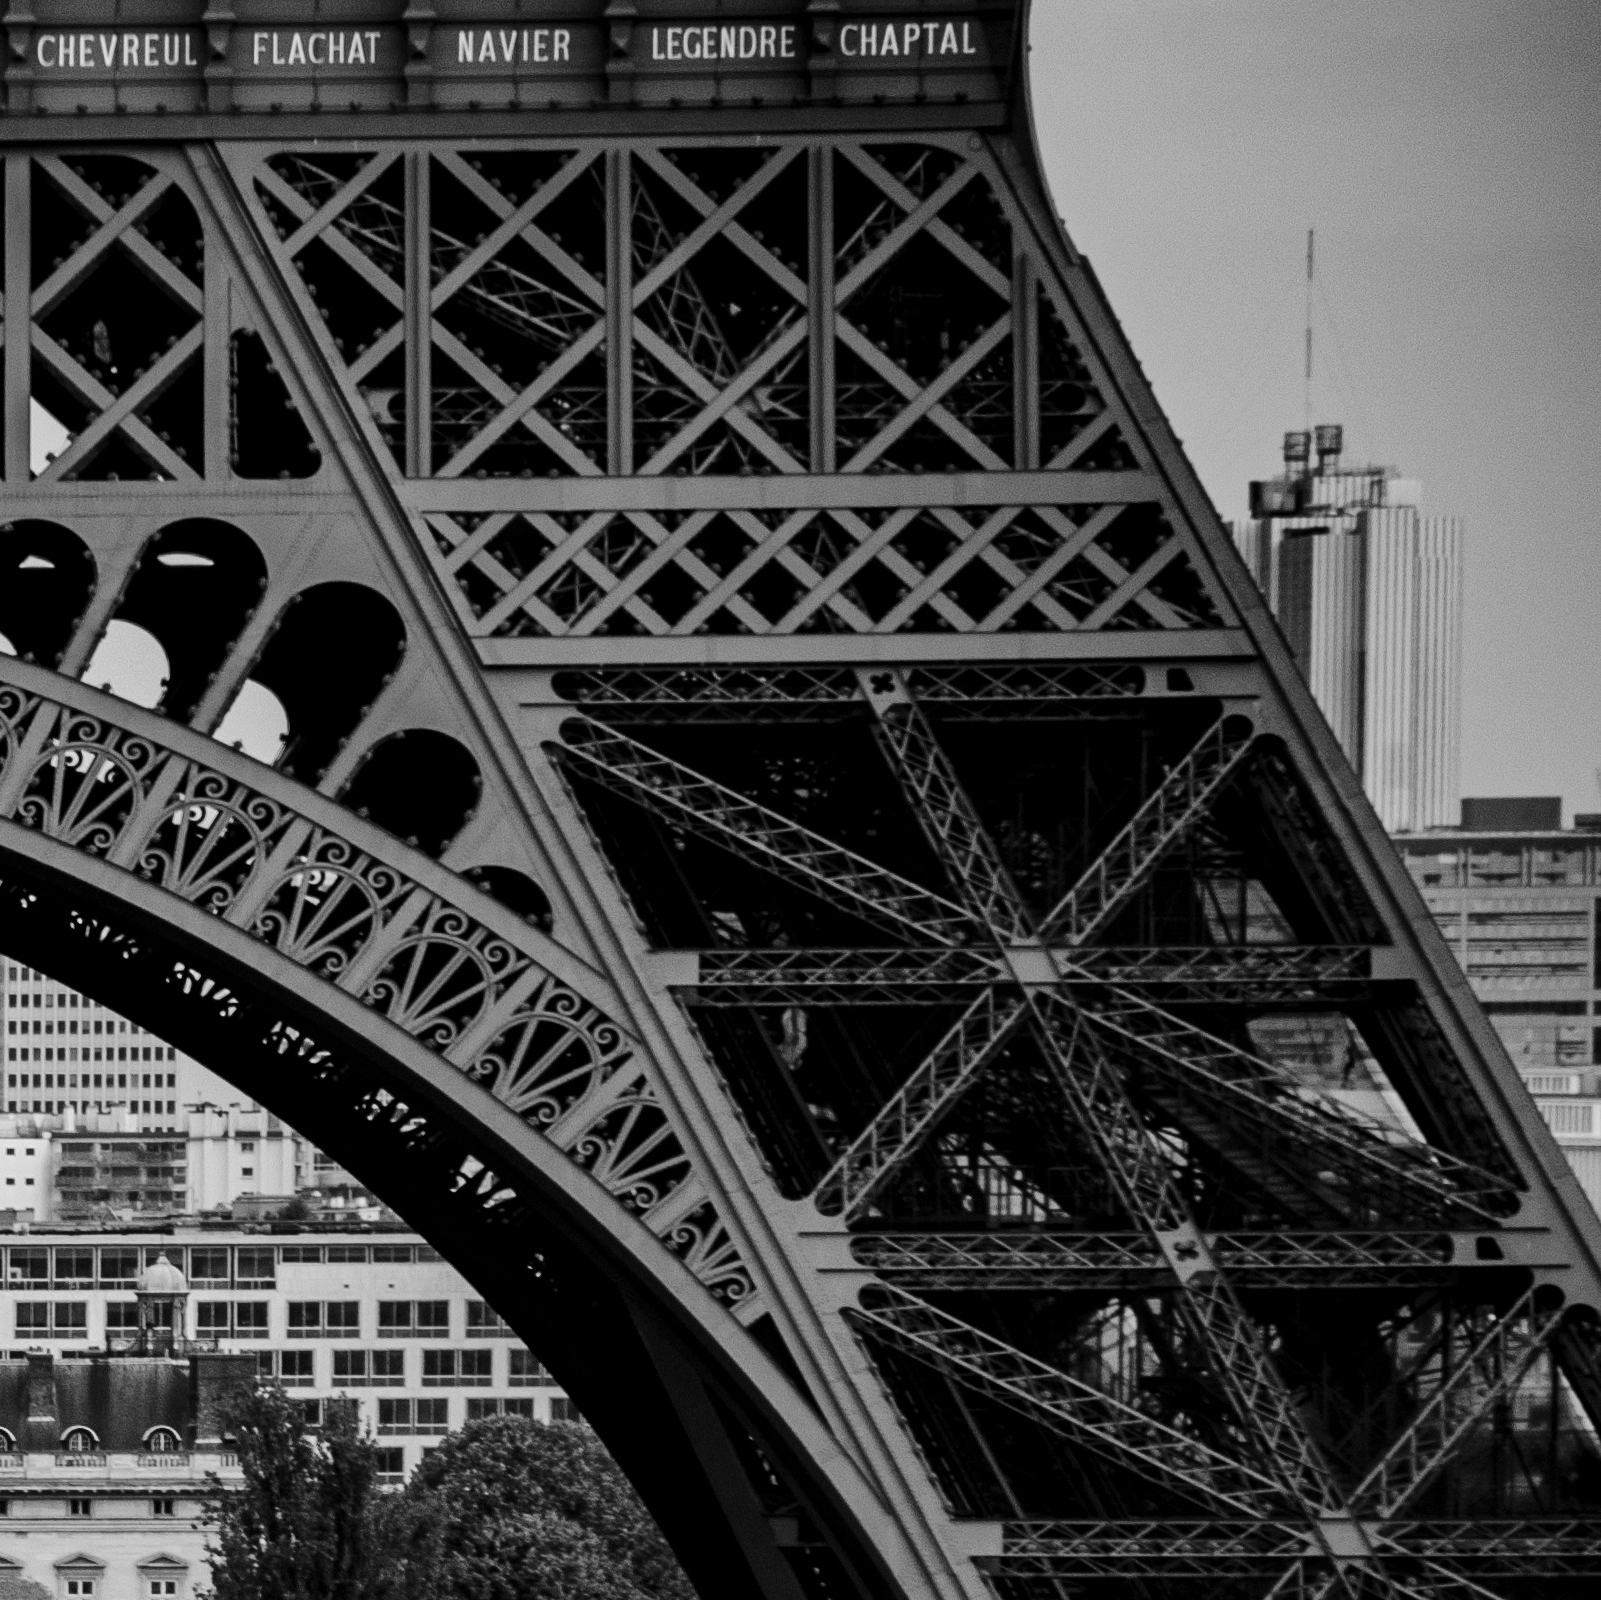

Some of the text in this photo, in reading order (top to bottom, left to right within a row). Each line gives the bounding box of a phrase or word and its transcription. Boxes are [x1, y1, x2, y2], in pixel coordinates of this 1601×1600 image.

[37, 33, 197, 67] CHEVREUL
[254, 31, 381, 64] FLACHAT
[458, 29, 570, 62] NAVIER
[652, 26, 795, 60] LEGENDRE
[840, 22, 976, 56] CHAPTAL
